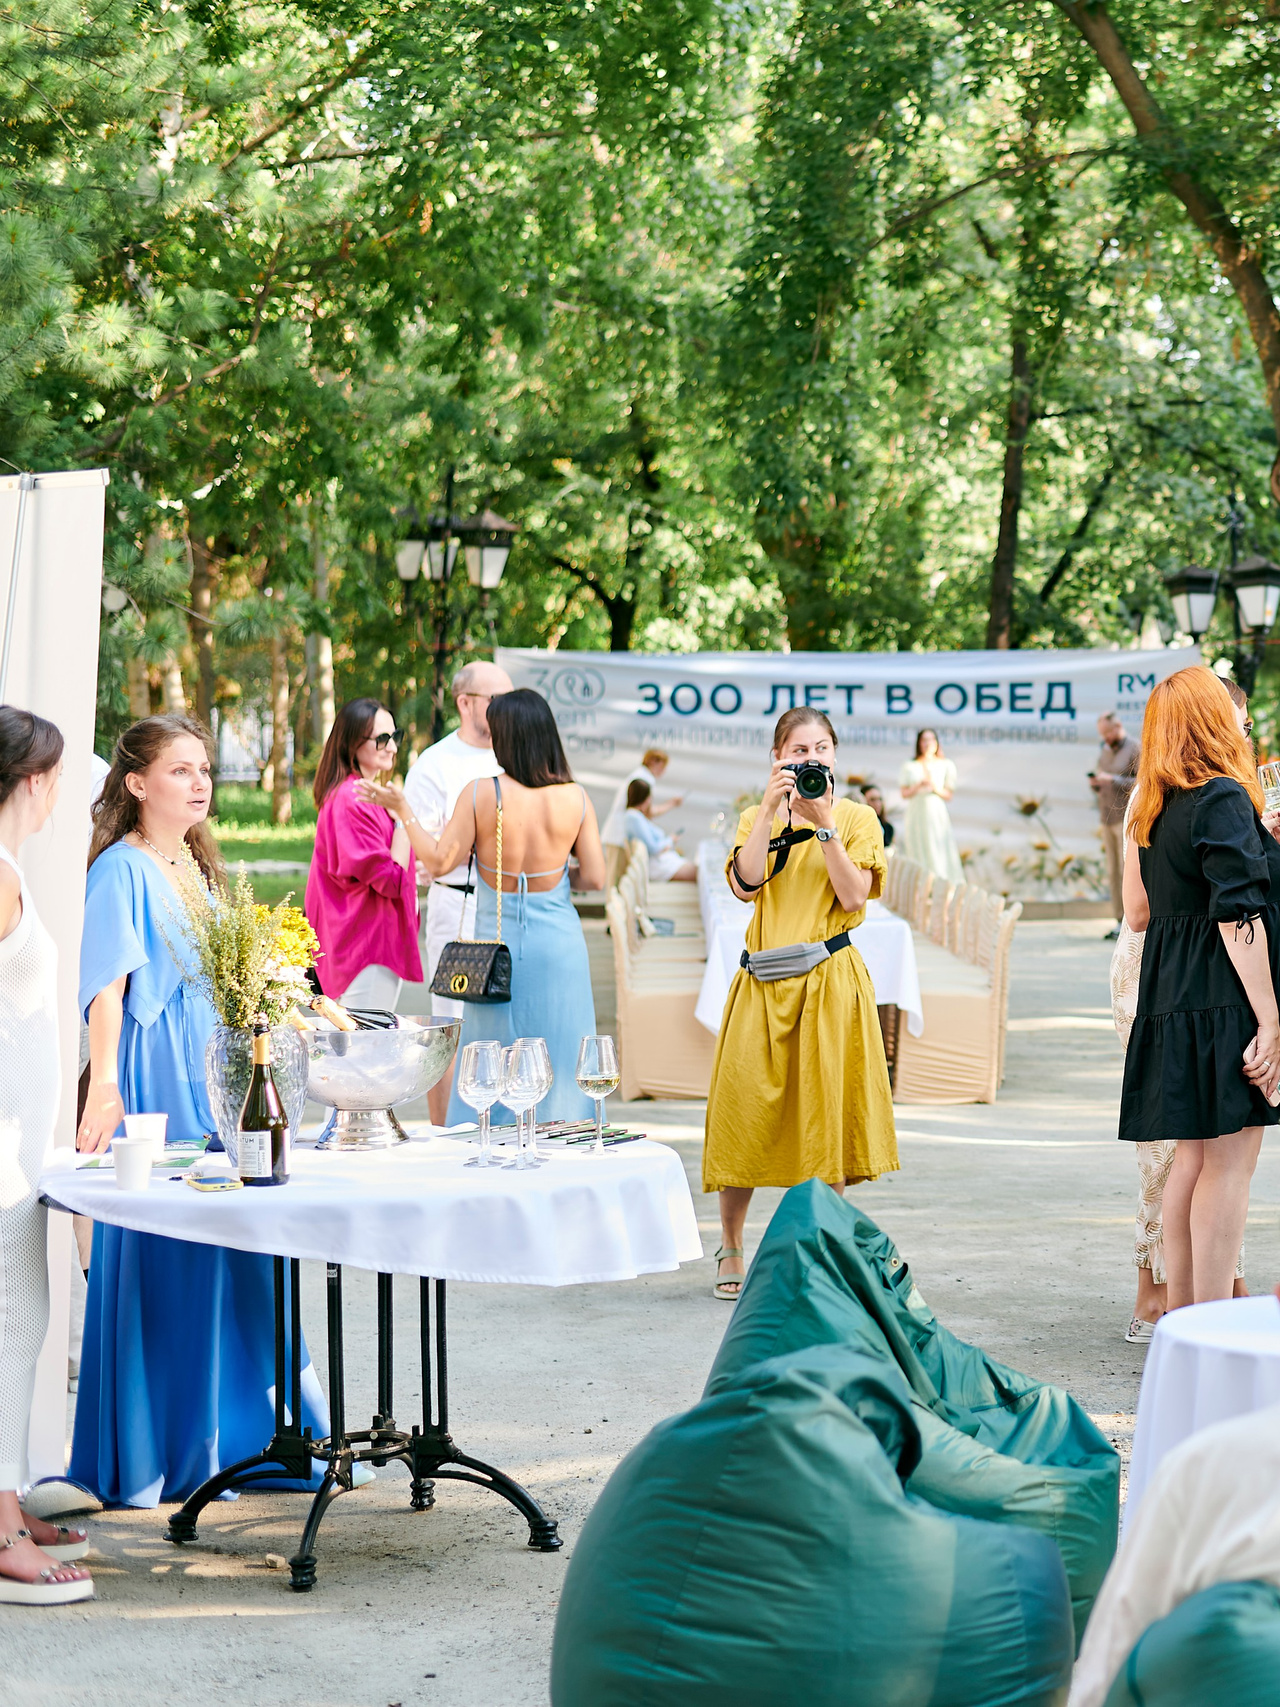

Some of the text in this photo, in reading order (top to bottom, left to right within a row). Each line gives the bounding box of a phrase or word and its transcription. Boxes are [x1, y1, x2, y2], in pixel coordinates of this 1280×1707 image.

[763, 684, 864, 716] ЛЕТ
[886, 684, 913, 715] В
[934, 682, 1077, 720] ОБЕД
